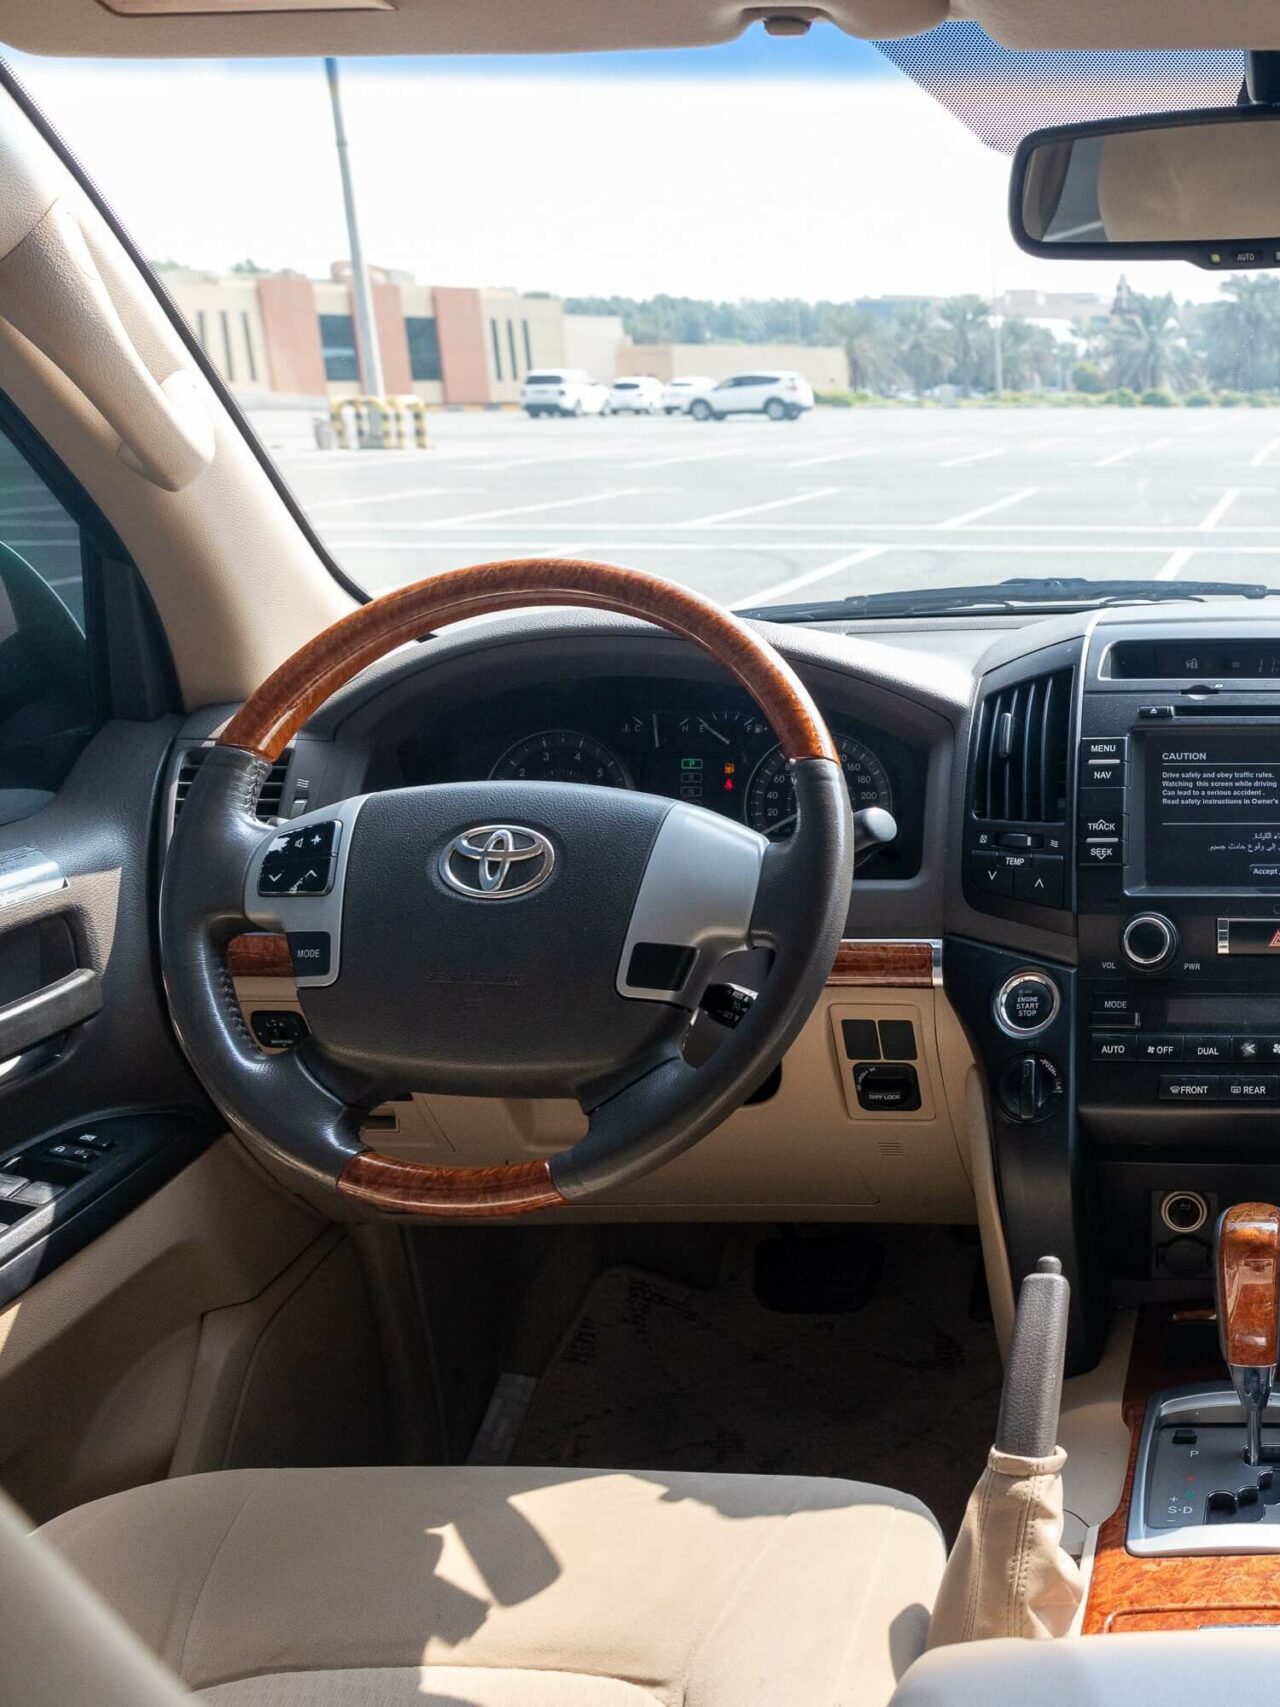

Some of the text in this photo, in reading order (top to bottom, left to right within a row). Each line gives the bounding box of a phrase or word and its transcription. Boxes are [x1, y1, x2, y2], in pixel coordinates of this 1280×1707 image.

[1237, 253, 1255, 261] AUTO
[682, 725, 689, 733] H
[746, 725, 752, 733] F
[1090, 744, 1116, 752] MENU
[543, 752, 549, 761] 3
[574, 752, 581, 761] 4
[1162, 752, 1207, 760] CAUTION
[847, 763, 861, 771] 160
[519, 768, 526, 777] 2
[597, 768, 603, 777] 5
[1093, 771, 1112, 779] NAV
[1181, 772, 1201, 780] safely
[1216, 772, 1233, 780] obey
[773, 775, 785, 783] 60
[857, 776, 871, 784] 180
[766, 791, 778, 800] 40
[860, 791, 878, 800] 200
[1180, 798, 1201, 806] safety
[767, 808, 778, 816] 20
[1087, 823, 1116, 831] TRACK
[1090, 848, 1113, 856] SEEK
[1006, 857, 1025, 866] TEMP
[1253, 868, 1278, 876] Accept
[297, 949, 320, 958] MODE
[1101, 1045, 1125, 1054] AUTO
[1156, 1046, 1174, 1055] OFF
[1197, 1047, 1220, 1055] DUAL
[1180, 1086, 1209, 1094] FRONT
[1243, 1086, 1266, 1095] REAR
[1189, 1450, 1199, 1458] P
